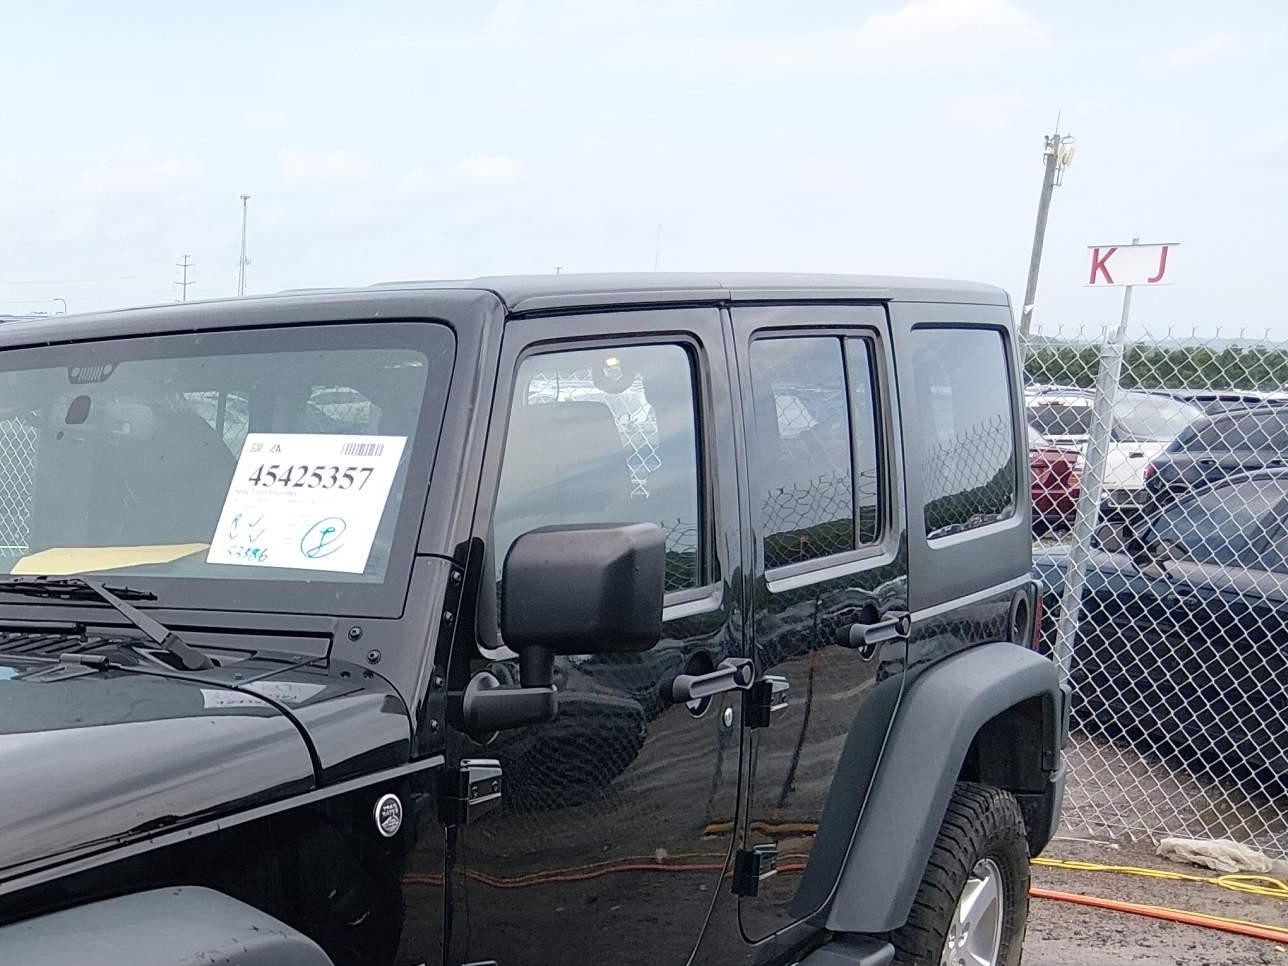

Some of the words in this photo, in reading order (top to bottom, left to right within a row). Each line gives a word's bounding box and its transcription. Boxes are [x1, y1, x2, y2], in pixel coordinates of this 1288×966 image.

[1089, 247, 1118, 285] K
[1147, 245, 1169, 284] J
[248, 464, 374, 490] 45425357
